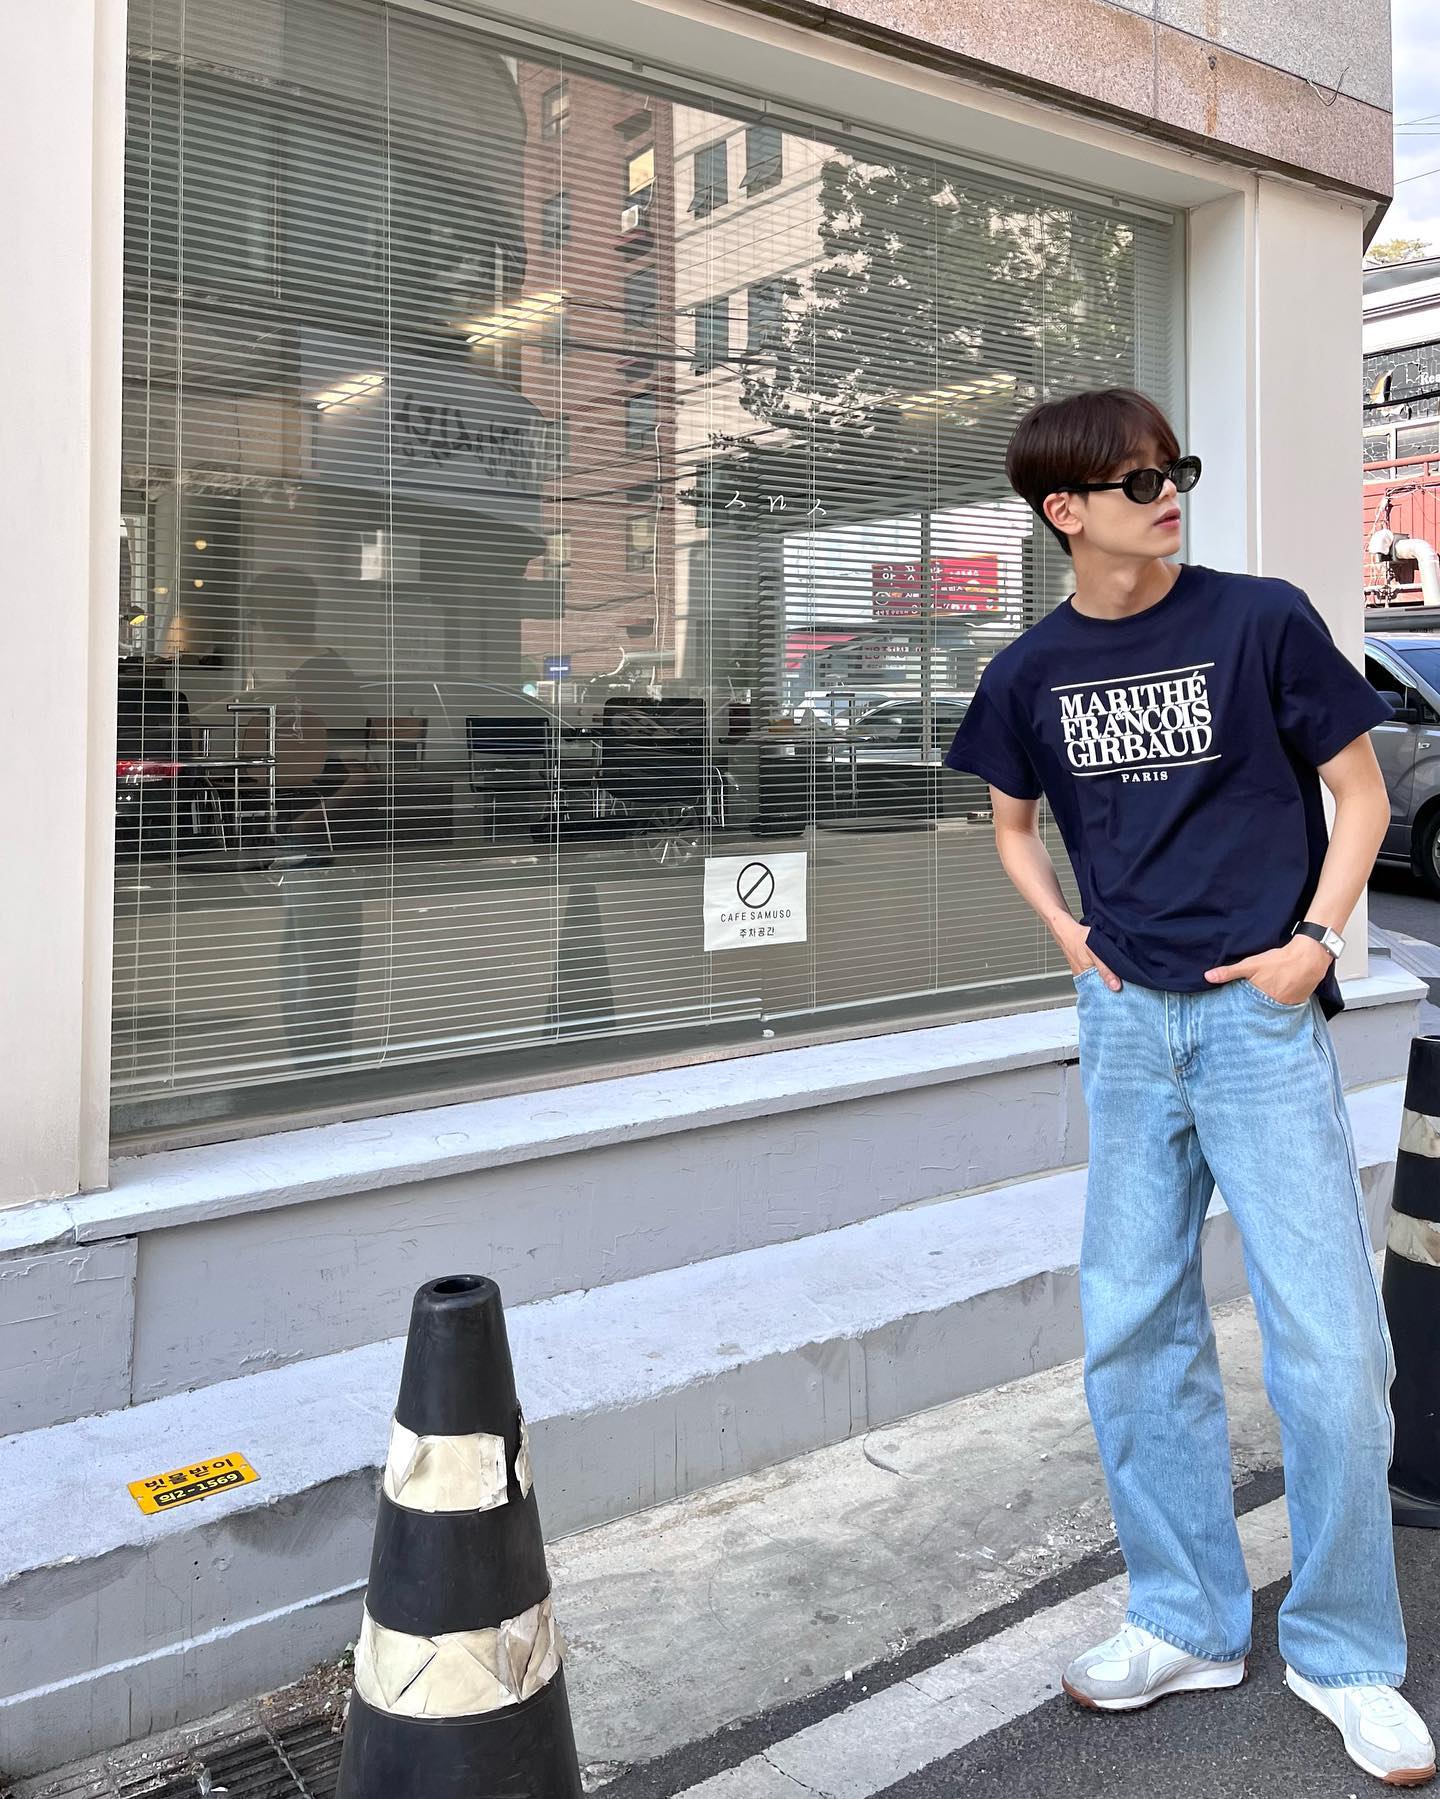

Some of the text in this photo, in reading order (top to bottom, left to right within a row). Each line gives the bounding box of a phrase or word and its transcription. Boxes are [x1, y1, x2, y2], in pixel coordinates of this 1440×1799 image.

[1059, 671, 1208, 720] MARITHÉ
[1066, 725, 1213, 768] GIRBAUD
[1121, 771, 1169, 783] PARIS
[720, 909, 792, 923] CAFE SAMUSO
[739, 926, 775, 938] 주차공간
[144, 1458, 234, 1491] 빗물받이
